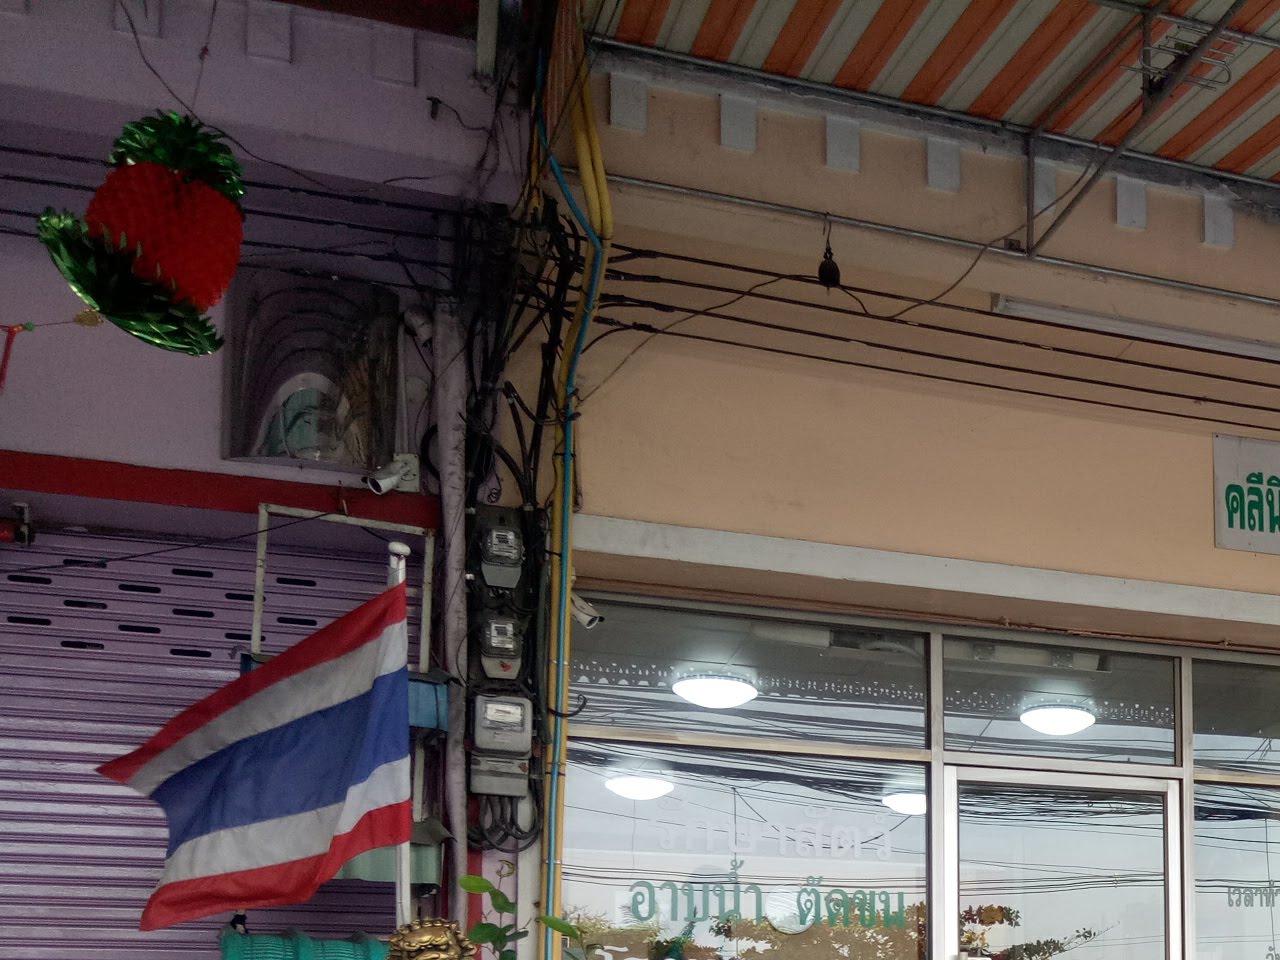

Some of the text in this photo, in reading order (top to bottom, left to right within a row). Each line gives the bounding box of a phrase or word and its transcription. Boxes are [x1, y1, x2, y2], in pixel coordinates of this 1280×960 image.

[628, 859, 906, 928] อาบน้ำ ตัดขน
